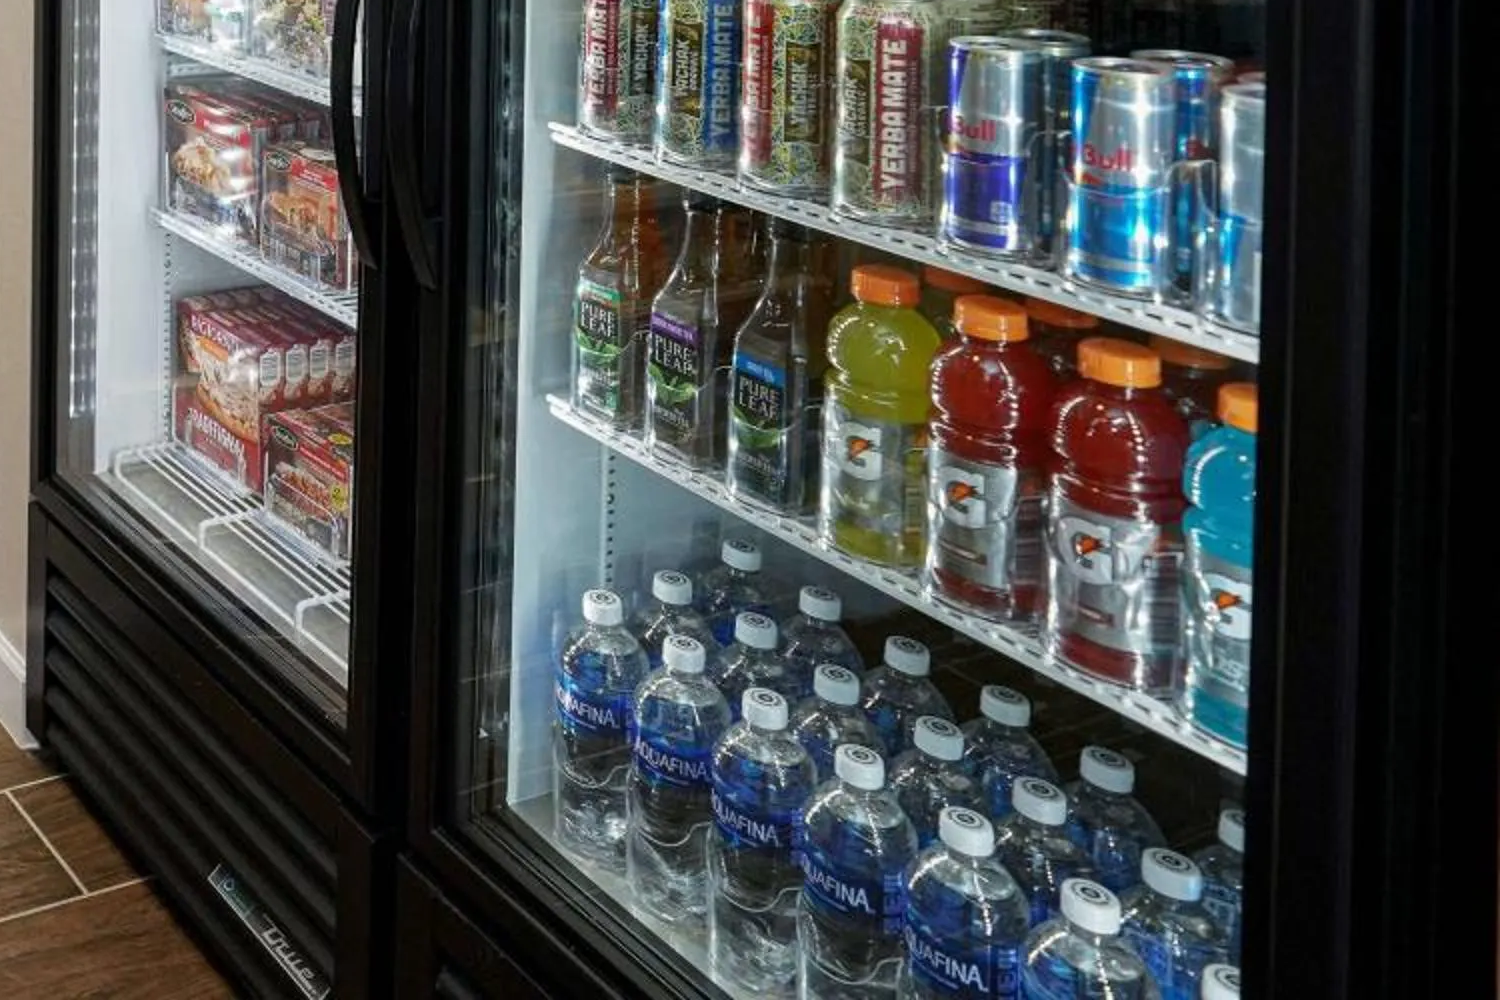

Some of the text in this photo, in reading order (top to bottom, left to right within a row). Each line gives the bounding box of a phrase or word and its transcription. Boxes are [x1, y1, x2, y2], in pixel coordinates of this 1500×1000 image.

[590, 44, 607, 108] YERBA
[634, 24, 649, 81] YACHAK
[675, 39, 690, 97] YACHAK
[711, 3, 732, 137] YERBA MATE
[881, 39, 908, 189] YERBA MATE
[581, 300, 616, 324] PURE
[581, 315, 614, 338] LEAF
[655, 333, 693, 359] PURE
[655, 350, 694, 375] LEAF
[739, 377, 779, 404] PURE
[739, 393, 779, 420] LEAF
[940, 466, 986, 528] G
[1057, 514, 1114, 585] G
[635, 737, 712, 781] AQUAFINA
